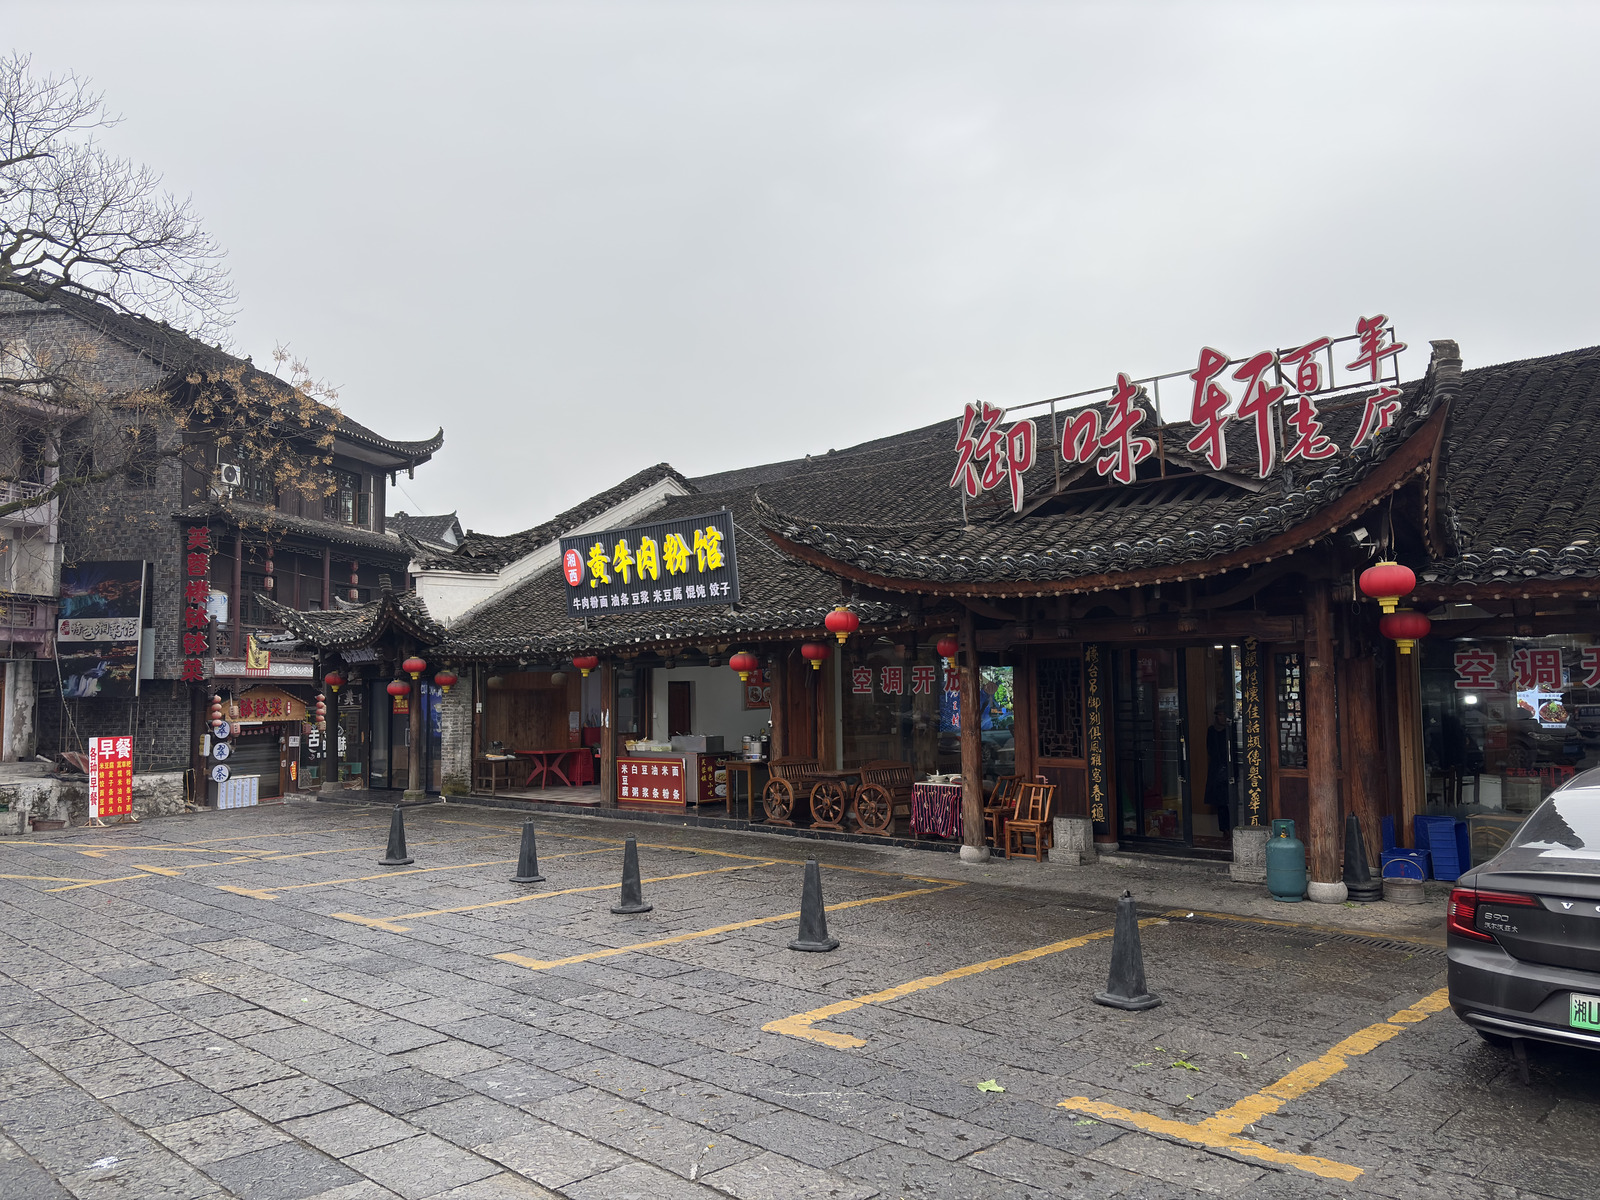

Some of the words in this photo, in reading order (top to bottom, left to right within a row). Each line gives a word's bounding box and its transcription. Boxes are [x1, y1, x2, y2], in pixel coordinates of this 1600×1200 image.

[1278, 313, 1408, 394] 百年
[949, 346, 1289, 513] 御味轩
[1283, 386, 1403, 464] 老店
[566, 552, 578, 583] 湘西
[586, 525, 725, 589] 黄牛肉粉馆
[181, 526, 211, 683] 芙蓉楼钵钵菜
[573, 594, 608, 611] 牛肉粉面
[611, 592, 629, 607] 油条
[631, 590, 650, 606] 豆浆
[653, 586, 683, 604] 米豆腐
[686, 584, 706, 599] 馄饨
[709, 582, 731, 597] 饺子
[71, 619, 138, 640] 特色湘菜馆
[239, 697, 282, 718] 钵钵菜
[99, 738, 131, 760] 早餐
[621, 764, 629, 797] 米豆腐
[631, 764, 639, 798] 白粥
[641, 765, 649, 798] 豆浆
[651, 765, 659, 799] 油条
[661, 765, 669, 799] 米粉
[671, 766, 680, 800] 面条
[1484, 912, 1509, 922] S90
[1484, 922, 1519, 933] 沃尔沃亚太
